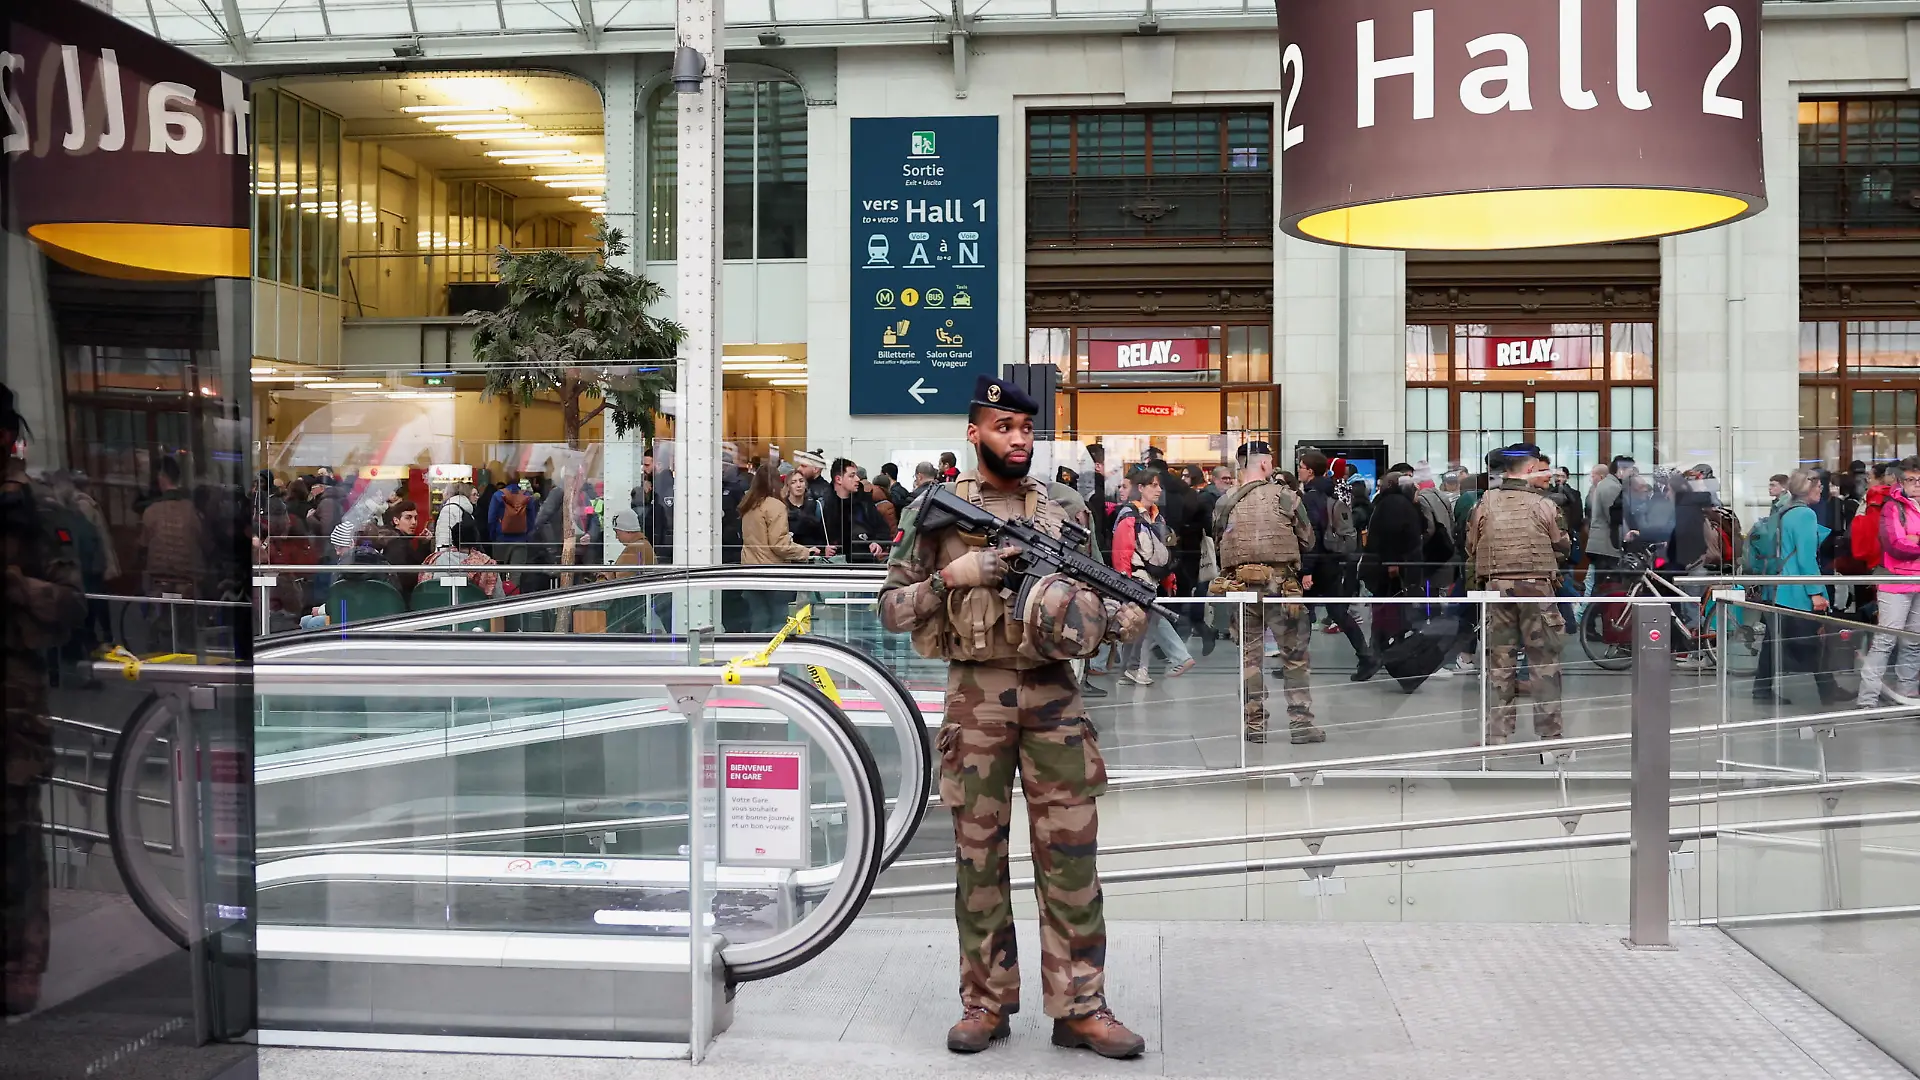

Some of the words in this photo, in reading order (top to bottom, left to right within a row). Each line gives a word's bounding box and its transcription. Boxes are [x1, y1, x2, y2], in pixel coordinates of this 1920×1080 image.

[1356, 0, 1653, 129] Hall
[1702, 5, 1744, 119] 2
[1282, 43, 1304, 152] 2
[902, 164, 945, 177] Sortie
[862, 200, 899, 211] vers
[906, 200, 964, 223] Hall
[972, 199, 986, 222] 1
[909, 243, 930, 264] A
[939, 240, 948, 252] à
[959, 243, 978, 264] N
[880, 293, 890, 303] M
[907, 292, 912, 303] 1
[878, 351, 915, 359] Billetterie
[926, 351, 948, 359] Salon
[949, 351, 973, 359] Grand
[1117, 340, 1173, 368] RELAY
[1496, 338, 1554, 367] RELAY
[931, 360, 968, 369] Voyageur
[1140, 406, 1170, 415] SNACKS
[730, 764, 773, 772] BIENVENUE
